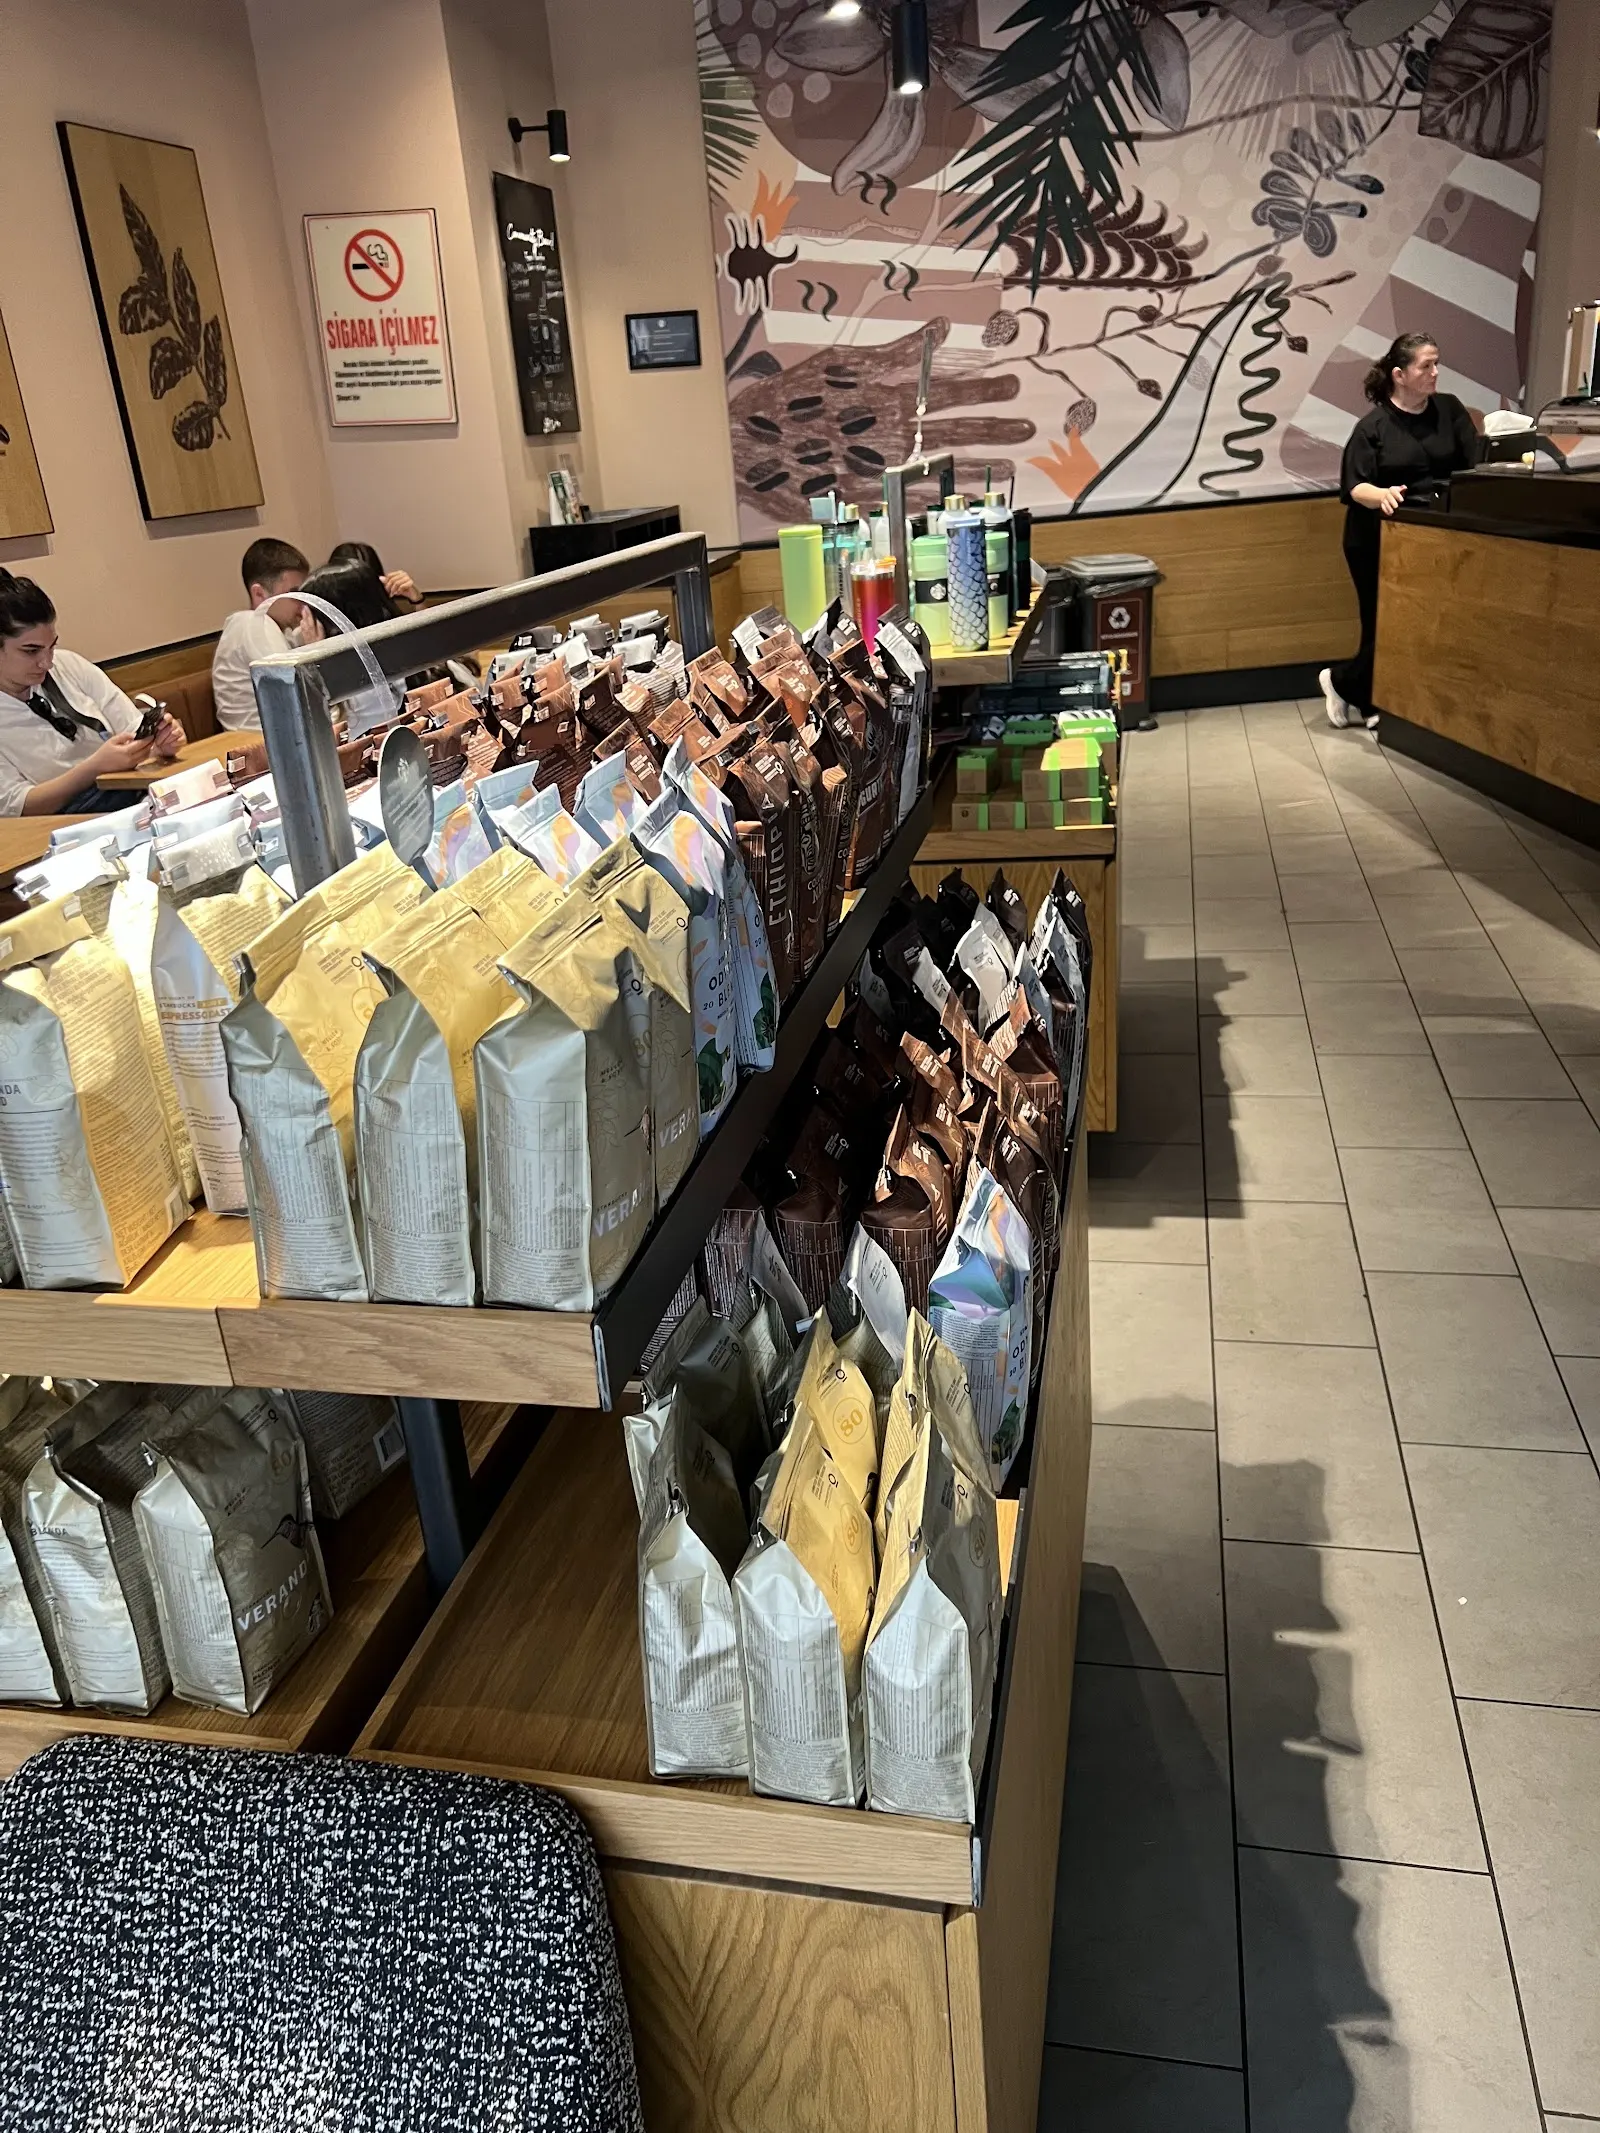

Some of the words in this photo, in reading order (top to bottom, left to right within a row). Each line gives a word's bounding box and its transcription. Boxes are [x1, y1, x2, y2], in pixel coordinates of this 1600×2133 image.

[326, 311, 378, 349] SİGARA
[380, 308, 439, 355] İÇİLMEZ
[762, 793, 788, 926] ETHIOPIA
[839, 1408, 863, 1437] 80
[847, 1515, 859, 1547] 80
